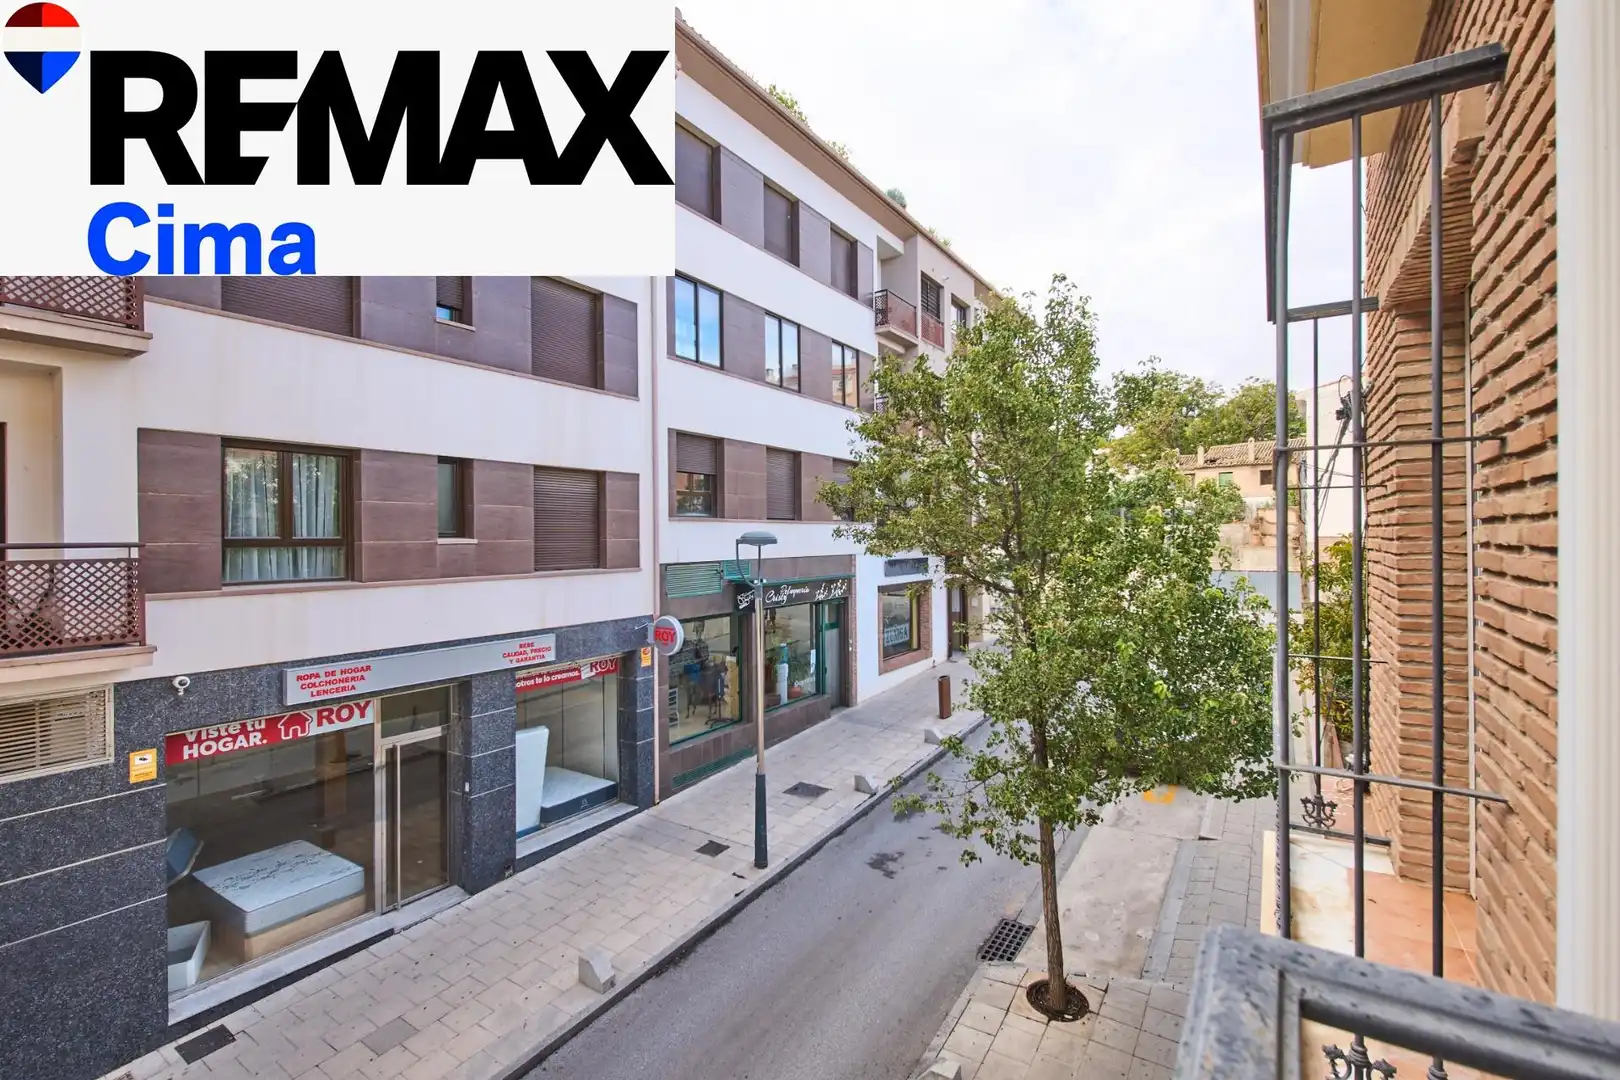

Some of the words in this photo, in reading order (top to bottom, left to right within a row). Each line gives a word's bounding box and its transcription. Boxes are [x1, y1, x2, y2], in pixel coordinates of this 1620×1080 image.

[296, 672, 320, 682] ROPA
[324, 670, 337, 678] DE
[340, 665, 372, 675] HOGAR
[590, 658, 617, 673] ROY
[300, 674, 366, 690] COLCHONERIA
[310, 685, 356, 697] LENCERIA
[316, 700, 372, 727] ROY
[184, 722, 241, 742] Viste
[246, 719, 266, 732] tu
[183, 732, 267, 760] HOGAR.
